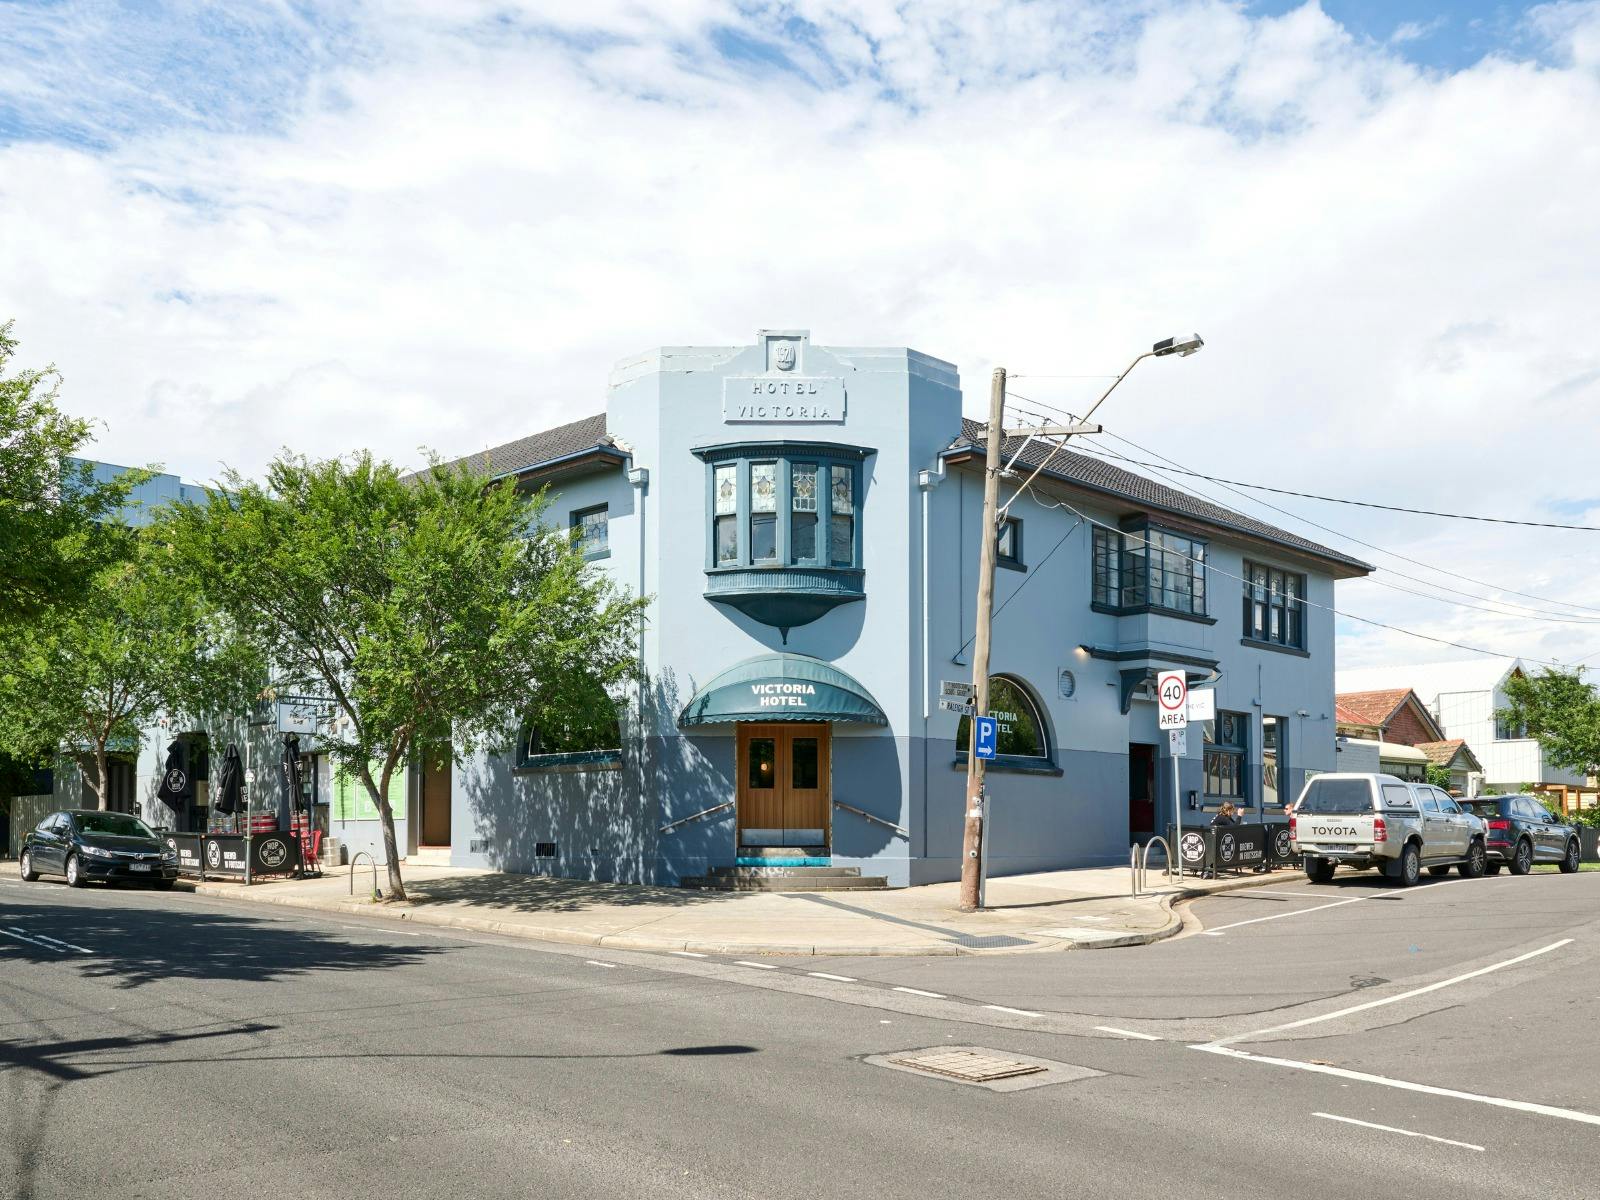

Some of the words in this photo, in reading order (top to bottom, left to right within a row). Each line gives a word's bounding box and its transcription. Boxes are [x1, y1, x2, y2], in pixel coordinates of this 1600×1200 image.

[753, 383, 817, 395] HOTEL
[739, 406, 830, 418] VICTORIA
[751, 684, 816, 695] VICTORIA
[1163, 685, 1181, 700] 40
[760, 696, 807, 707] HOTEL
[988, 711, 1018, 721] CTORIA
[1161, 713, 1185, 725] AREA
[980, 722, 992, 743] P
[997, 724, 1013, 733] TEL
[1311, 826, 1357, 836] TOYOTA
[1187, 835, 1199, 844] HOP
